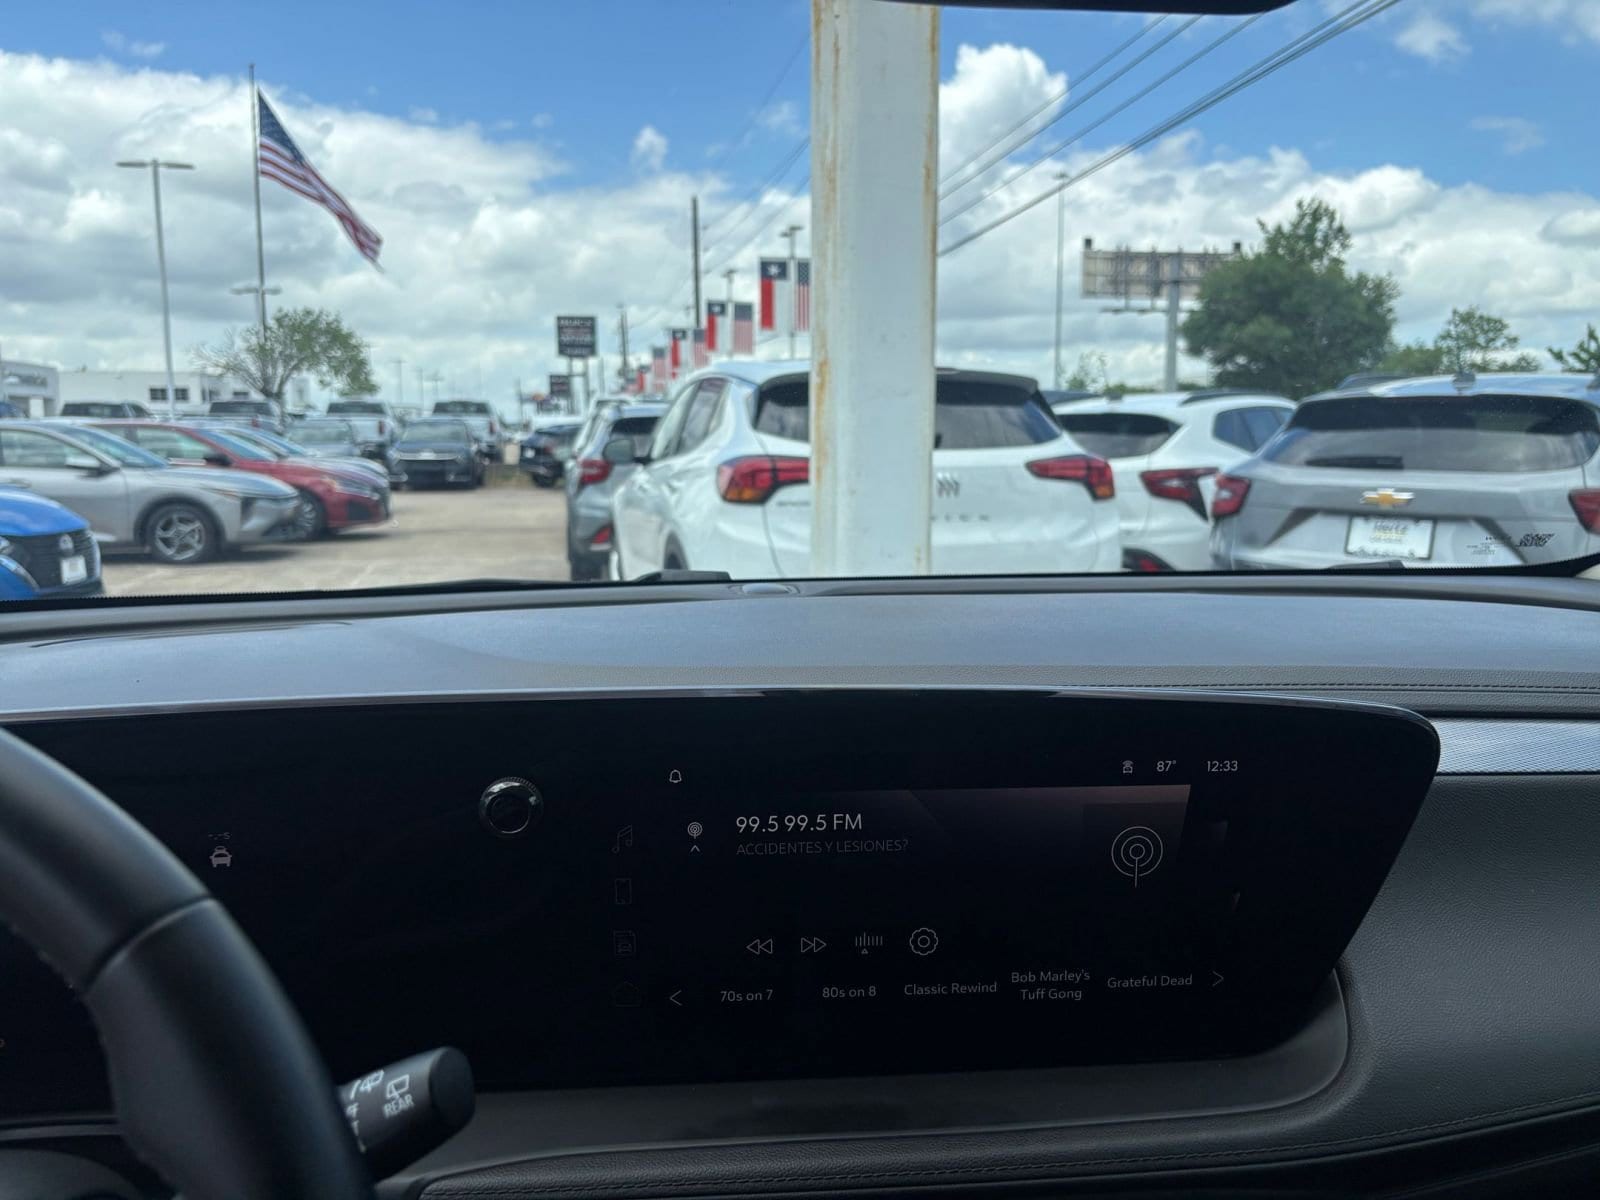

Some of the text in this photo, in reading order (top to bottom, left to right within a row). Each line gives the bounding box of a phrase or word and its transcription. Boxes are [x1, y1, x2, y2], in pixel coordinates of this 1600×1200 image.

[1156, 760, 1177, 773] 87°
[1206, 760, 1239, 773] 12:33
[735, 813, 863, 833] 99.5 99.5 FM
[735, 838, 909, 856] ACCIDENTES Y LESIONES?
[1011, 969, 1091, 985] Bob Marley's
[1107, 973, 1193, 989] Grateful Dead
[720, 988, 774, 1002] 70s on 7
[822, 985, 877, 999] 80s on 8
[903, 981, 998, 996] Classic Rewind
[1020, 987, 1083, 1003] Tuff Gong
[383, 1094, 414, 1118] REAR
